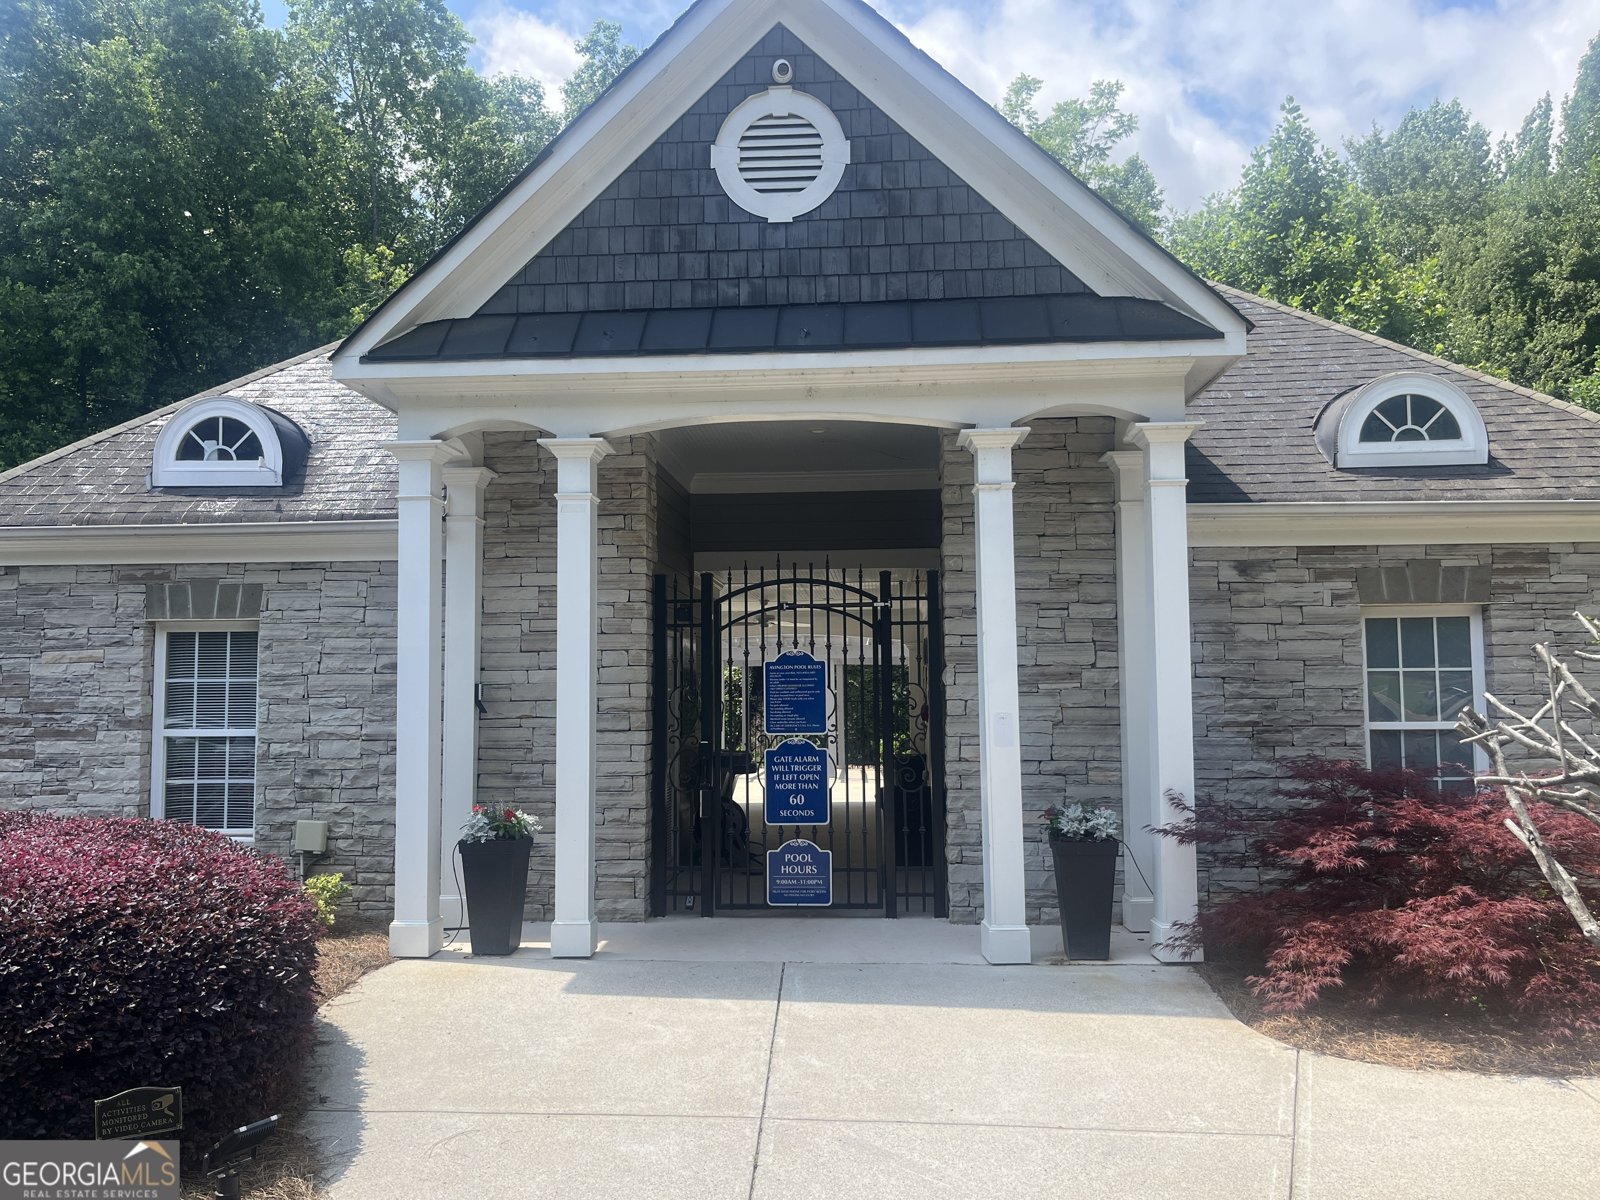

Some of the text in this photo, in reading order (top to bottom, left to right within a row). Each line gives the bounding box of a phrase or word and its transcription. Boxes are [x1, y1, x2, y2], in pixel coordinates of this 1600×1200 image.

[790, 794, 804, 805] 60
[785, 854, 812, 862] POOL
[781, 865, 817, 874] HOURS
[116, 1099, 130, 1107] ALL
[101, 1105, 146, 1118] ACTIVITIES
[101, 1113, 148, 1127] MONITORED
[102, 1118, 173, 1136] BY VIDEO CAMERA
